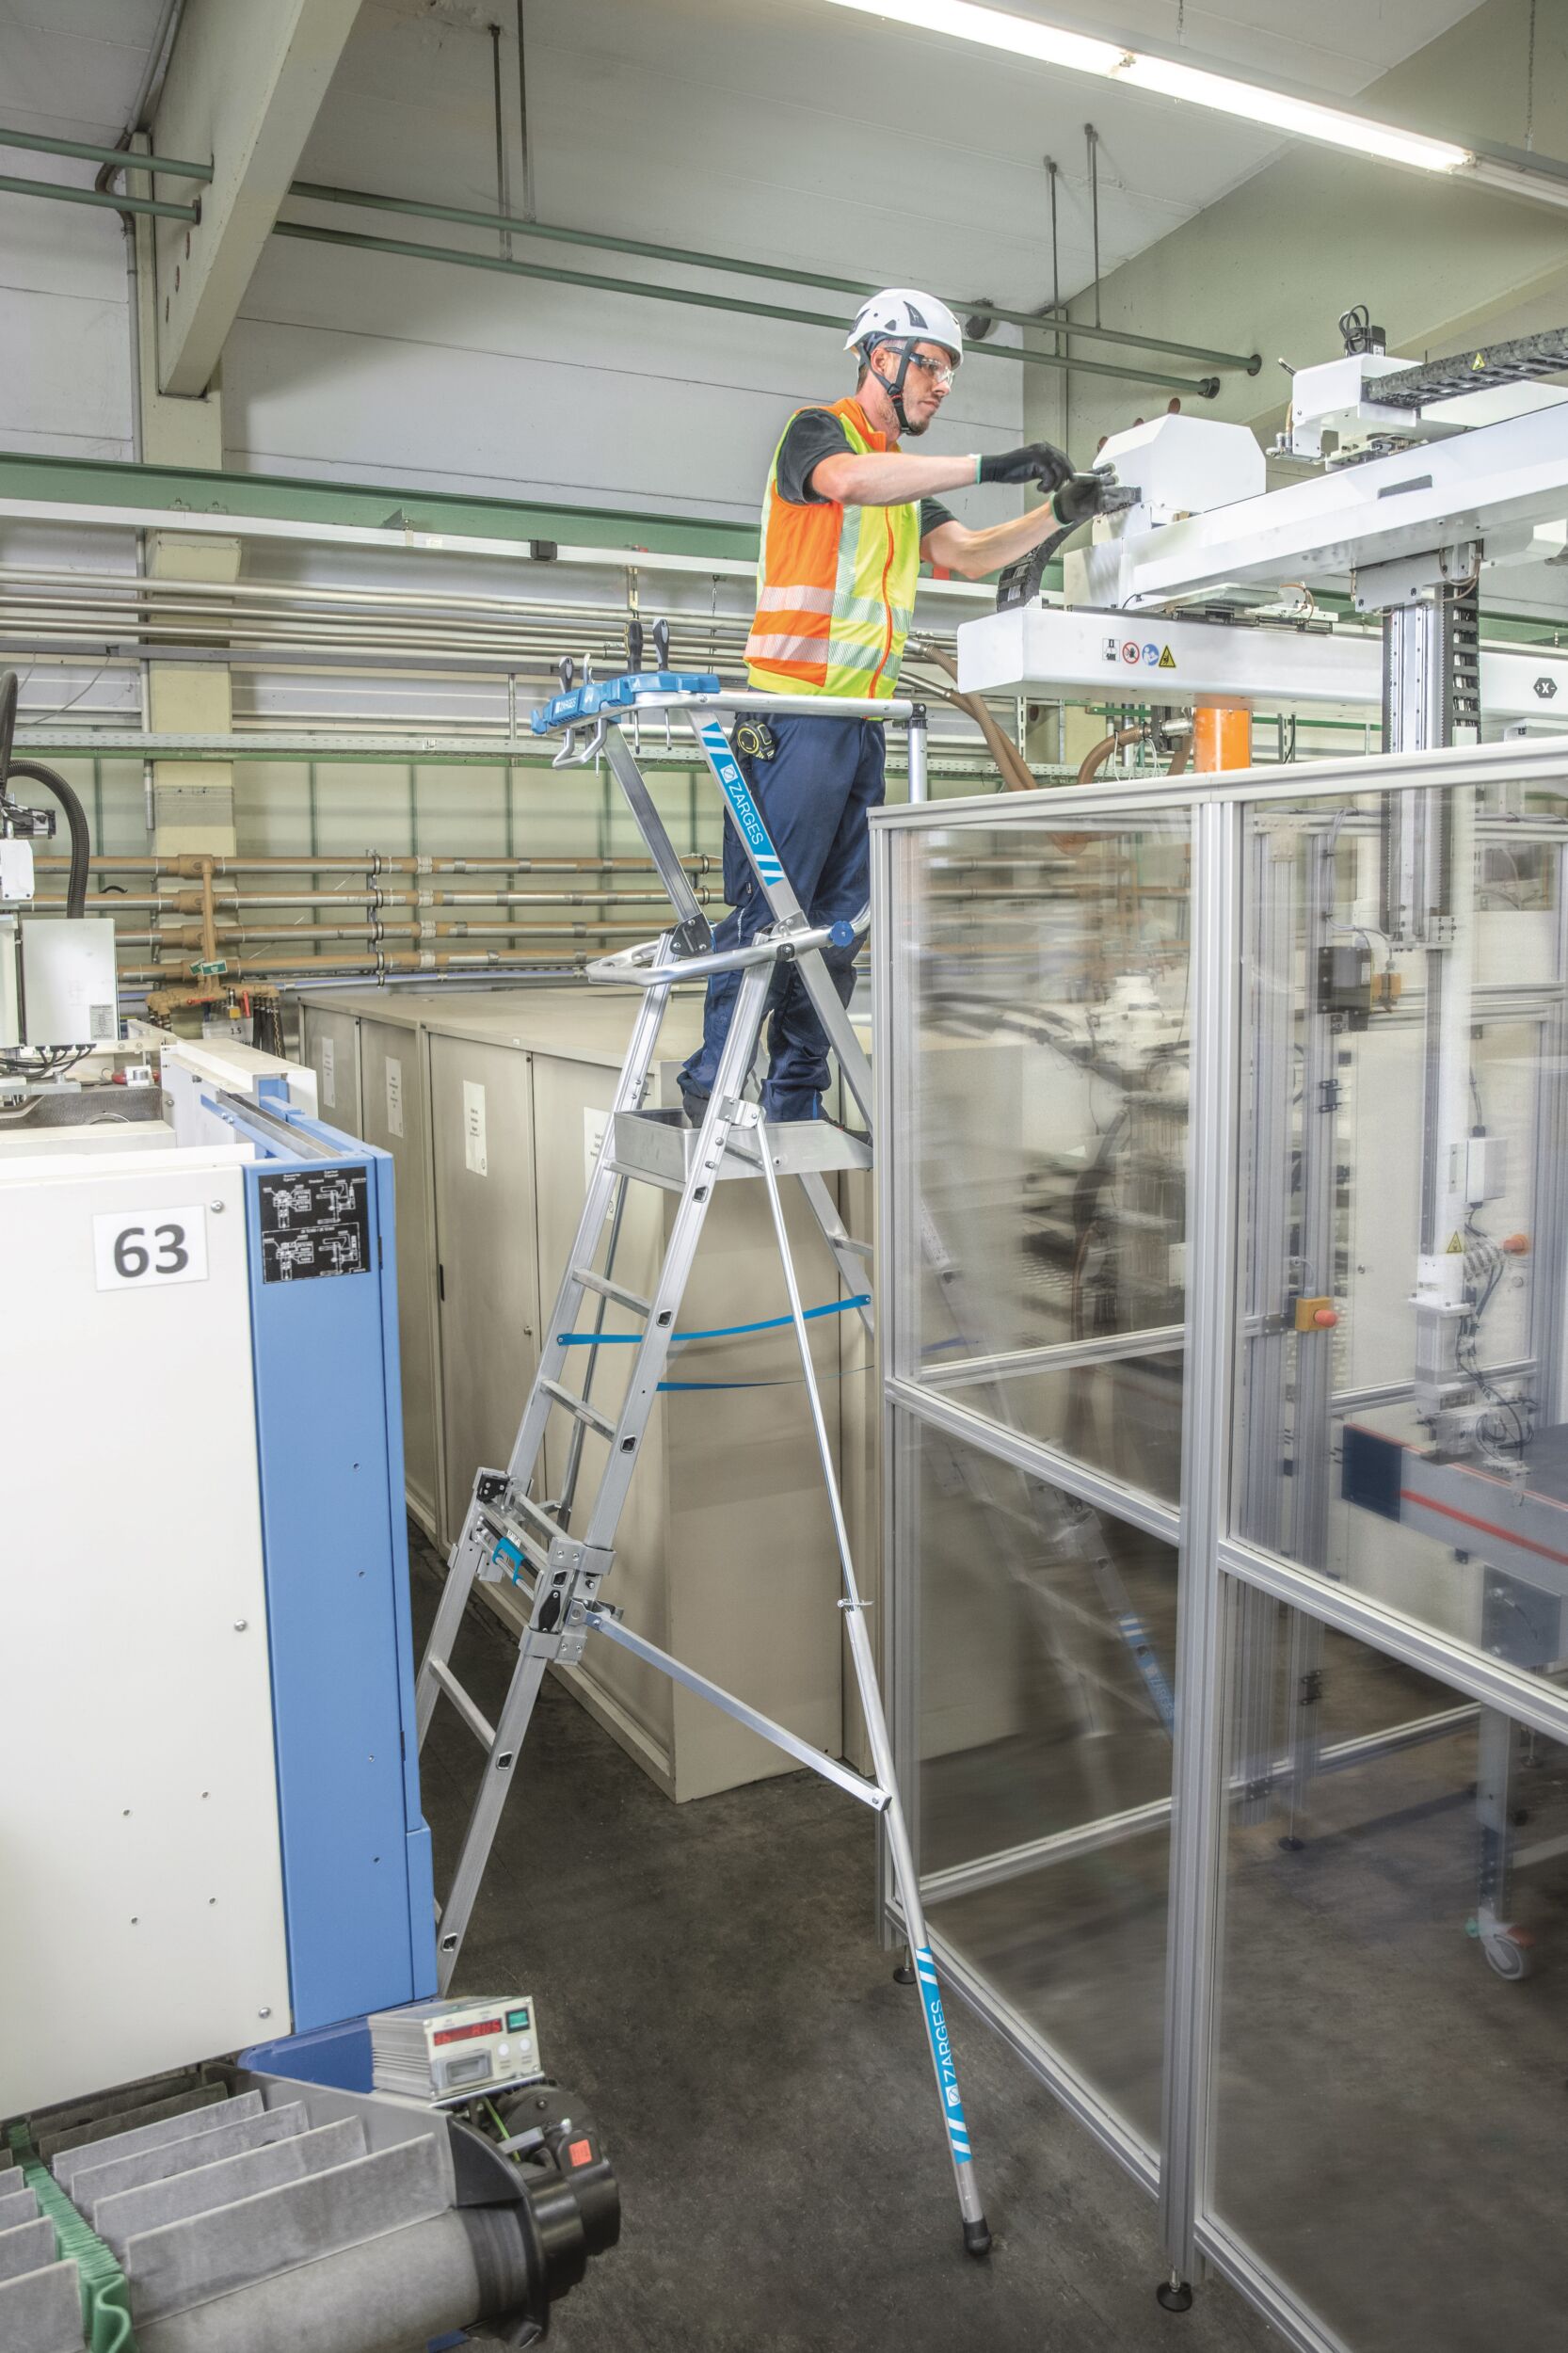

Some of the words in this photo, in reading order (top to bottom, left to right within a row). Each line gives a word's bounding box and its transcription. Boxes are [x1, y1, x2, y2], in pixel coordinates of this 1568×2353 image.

[728, 782, 764, 845] ZARGES
[114, 1223, 189, 1278] 63
[931, 1999, 957, 2083] ZARGES
